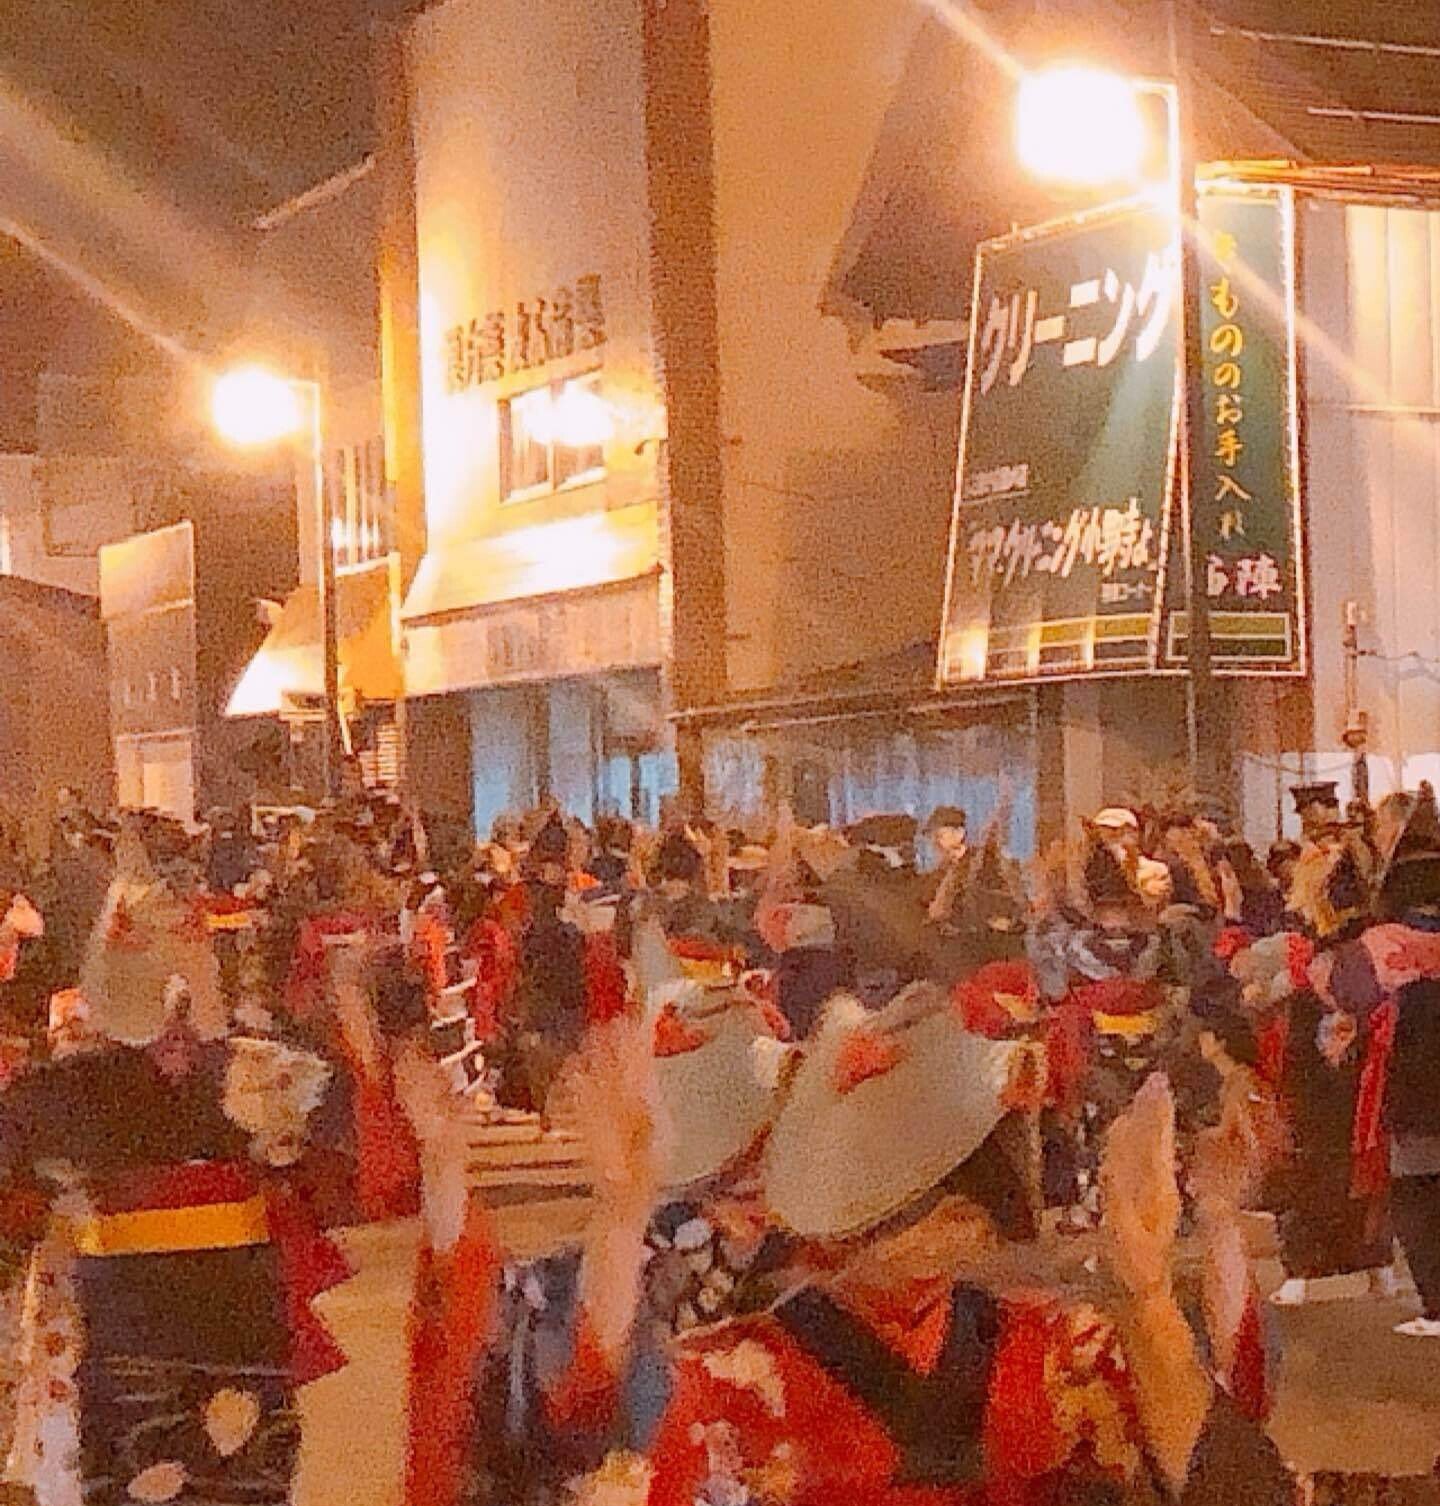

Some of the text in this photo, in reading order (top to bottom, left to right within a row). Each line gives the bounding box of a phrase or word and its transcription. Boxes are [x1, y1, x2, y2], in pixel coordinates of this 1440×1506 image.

[980, 250, 1174, 395] クリーニング
[1210, 232, 1251, 540] もののお手入れ
